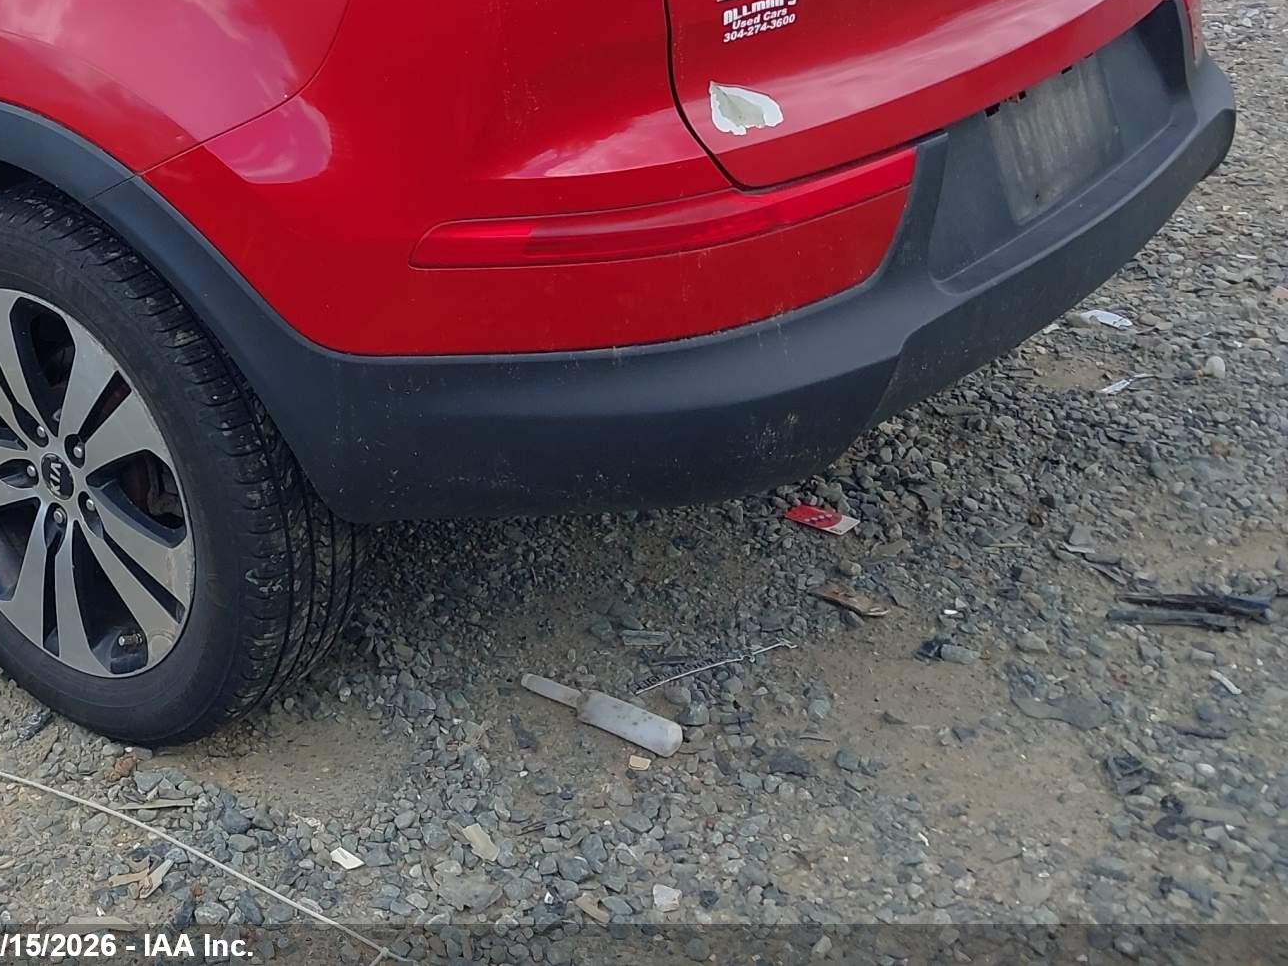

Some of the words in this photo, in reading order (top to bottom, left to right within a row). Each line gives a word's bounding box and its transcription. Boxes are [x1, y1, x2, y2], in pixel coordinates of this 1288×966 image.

[723, 13, 796, 43] 304-274-3600
[732, 13, 761, 30] Used
[763, 8, 788, 22] Cars
